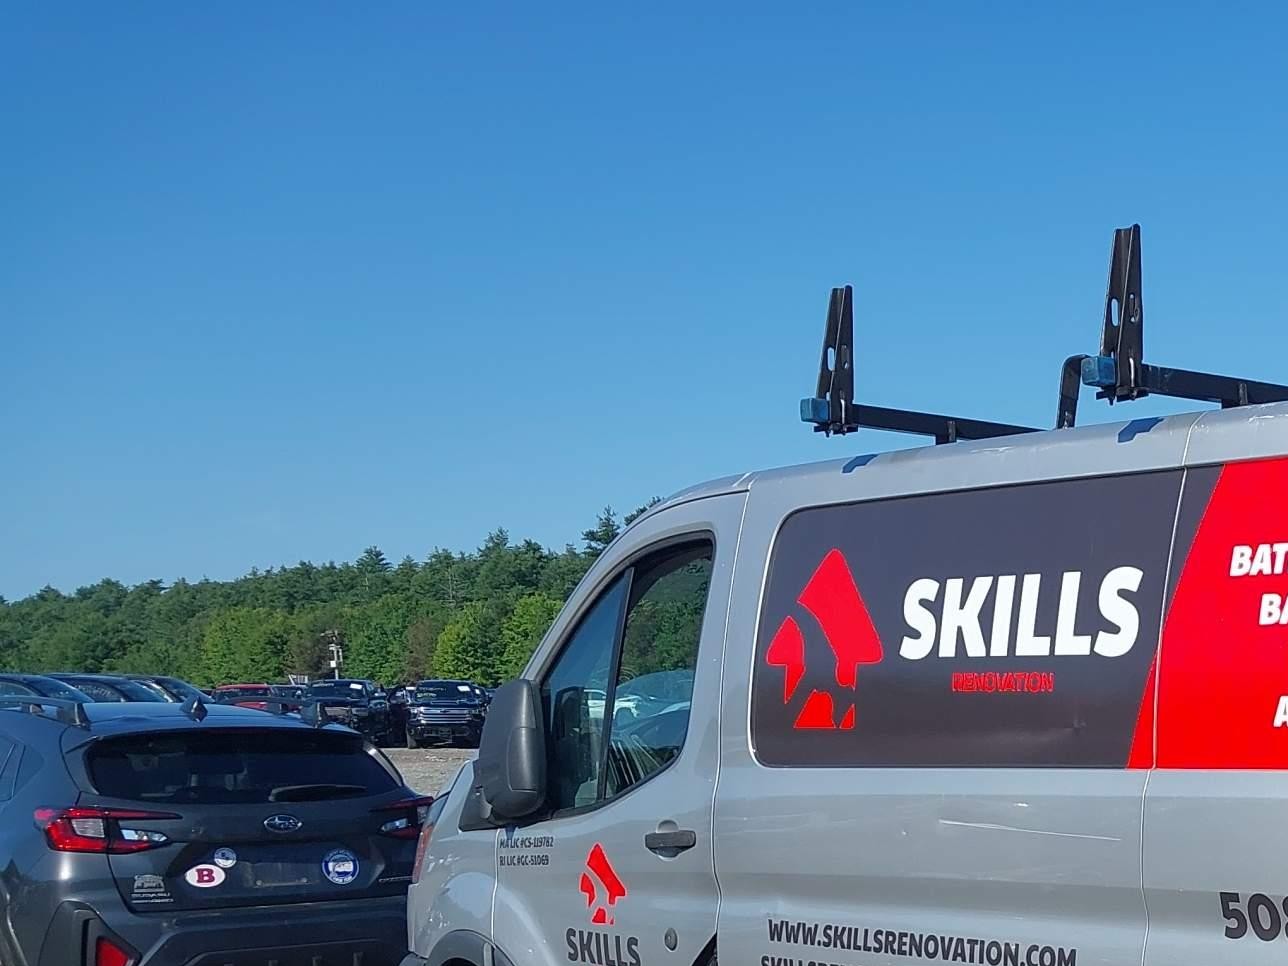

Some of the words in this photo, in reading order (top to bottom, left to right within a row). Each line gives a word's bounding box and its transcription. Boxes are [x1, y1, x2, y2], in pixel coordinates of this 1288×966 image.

[899, 565, 1145, 661] SKILLS
[952, 671, 1055, 693] RENOVATION
[510, 836, 519, 848] LIC
[507, 855, 516, 866] LIC
[196, 868, 216, 883] B
